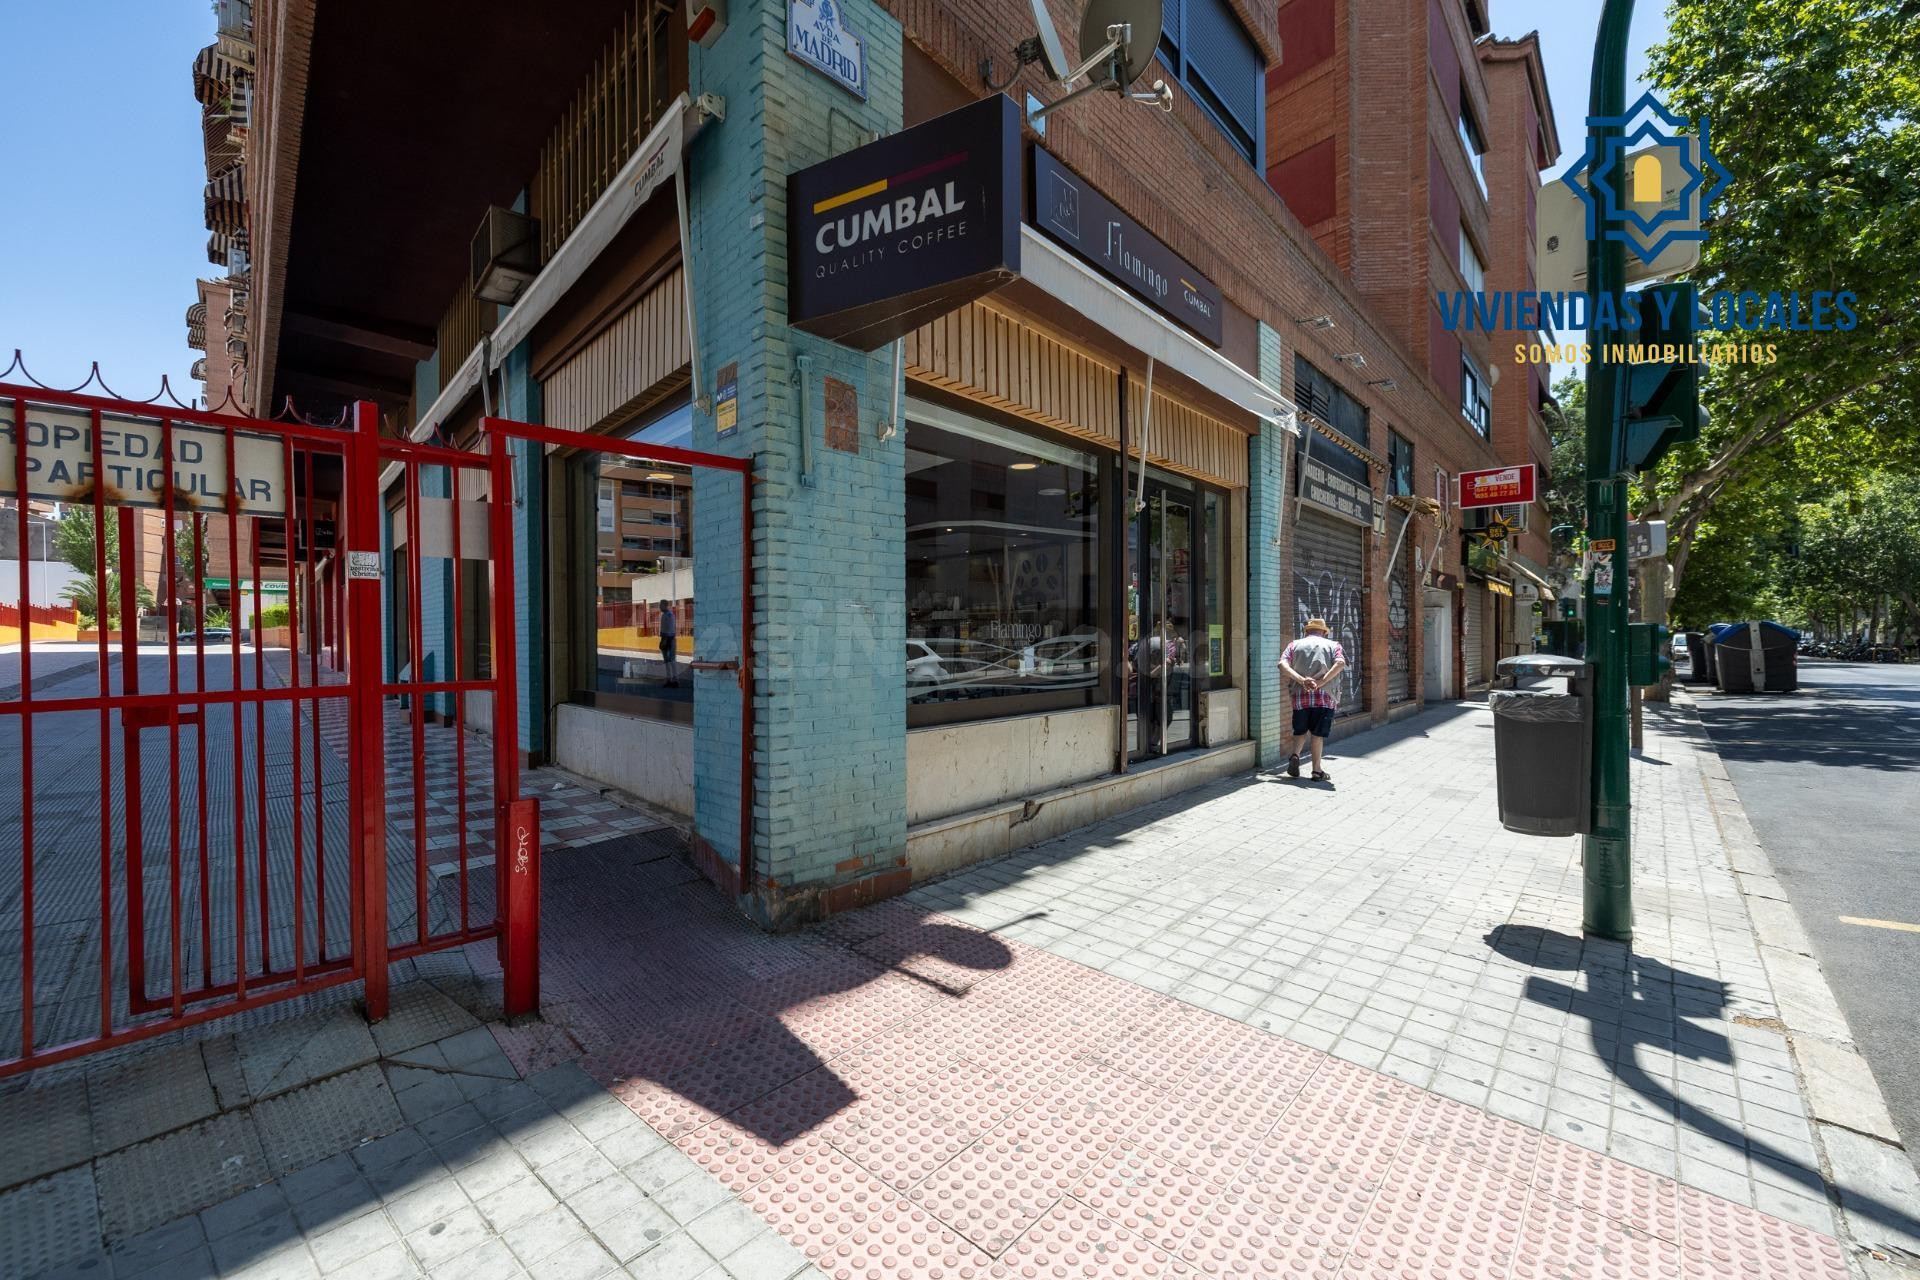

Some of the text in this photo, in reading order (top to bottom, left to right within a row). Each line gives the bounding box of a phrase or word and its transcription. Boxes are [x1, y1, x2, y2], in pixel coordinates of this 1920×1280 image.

[796, 24, 857, 83] MADRID
[815, 180, 966, 254] CUMBAL
[815, 221, 967, 279] QUALITY COFFEE
[1103, 221, 1169, 298] Flamingo
[1183, 290, 1212, 319] CUMBAL
[1495, 473, 1515, 482] VENDE
[990, 618, 1042, 643] Flamingo
